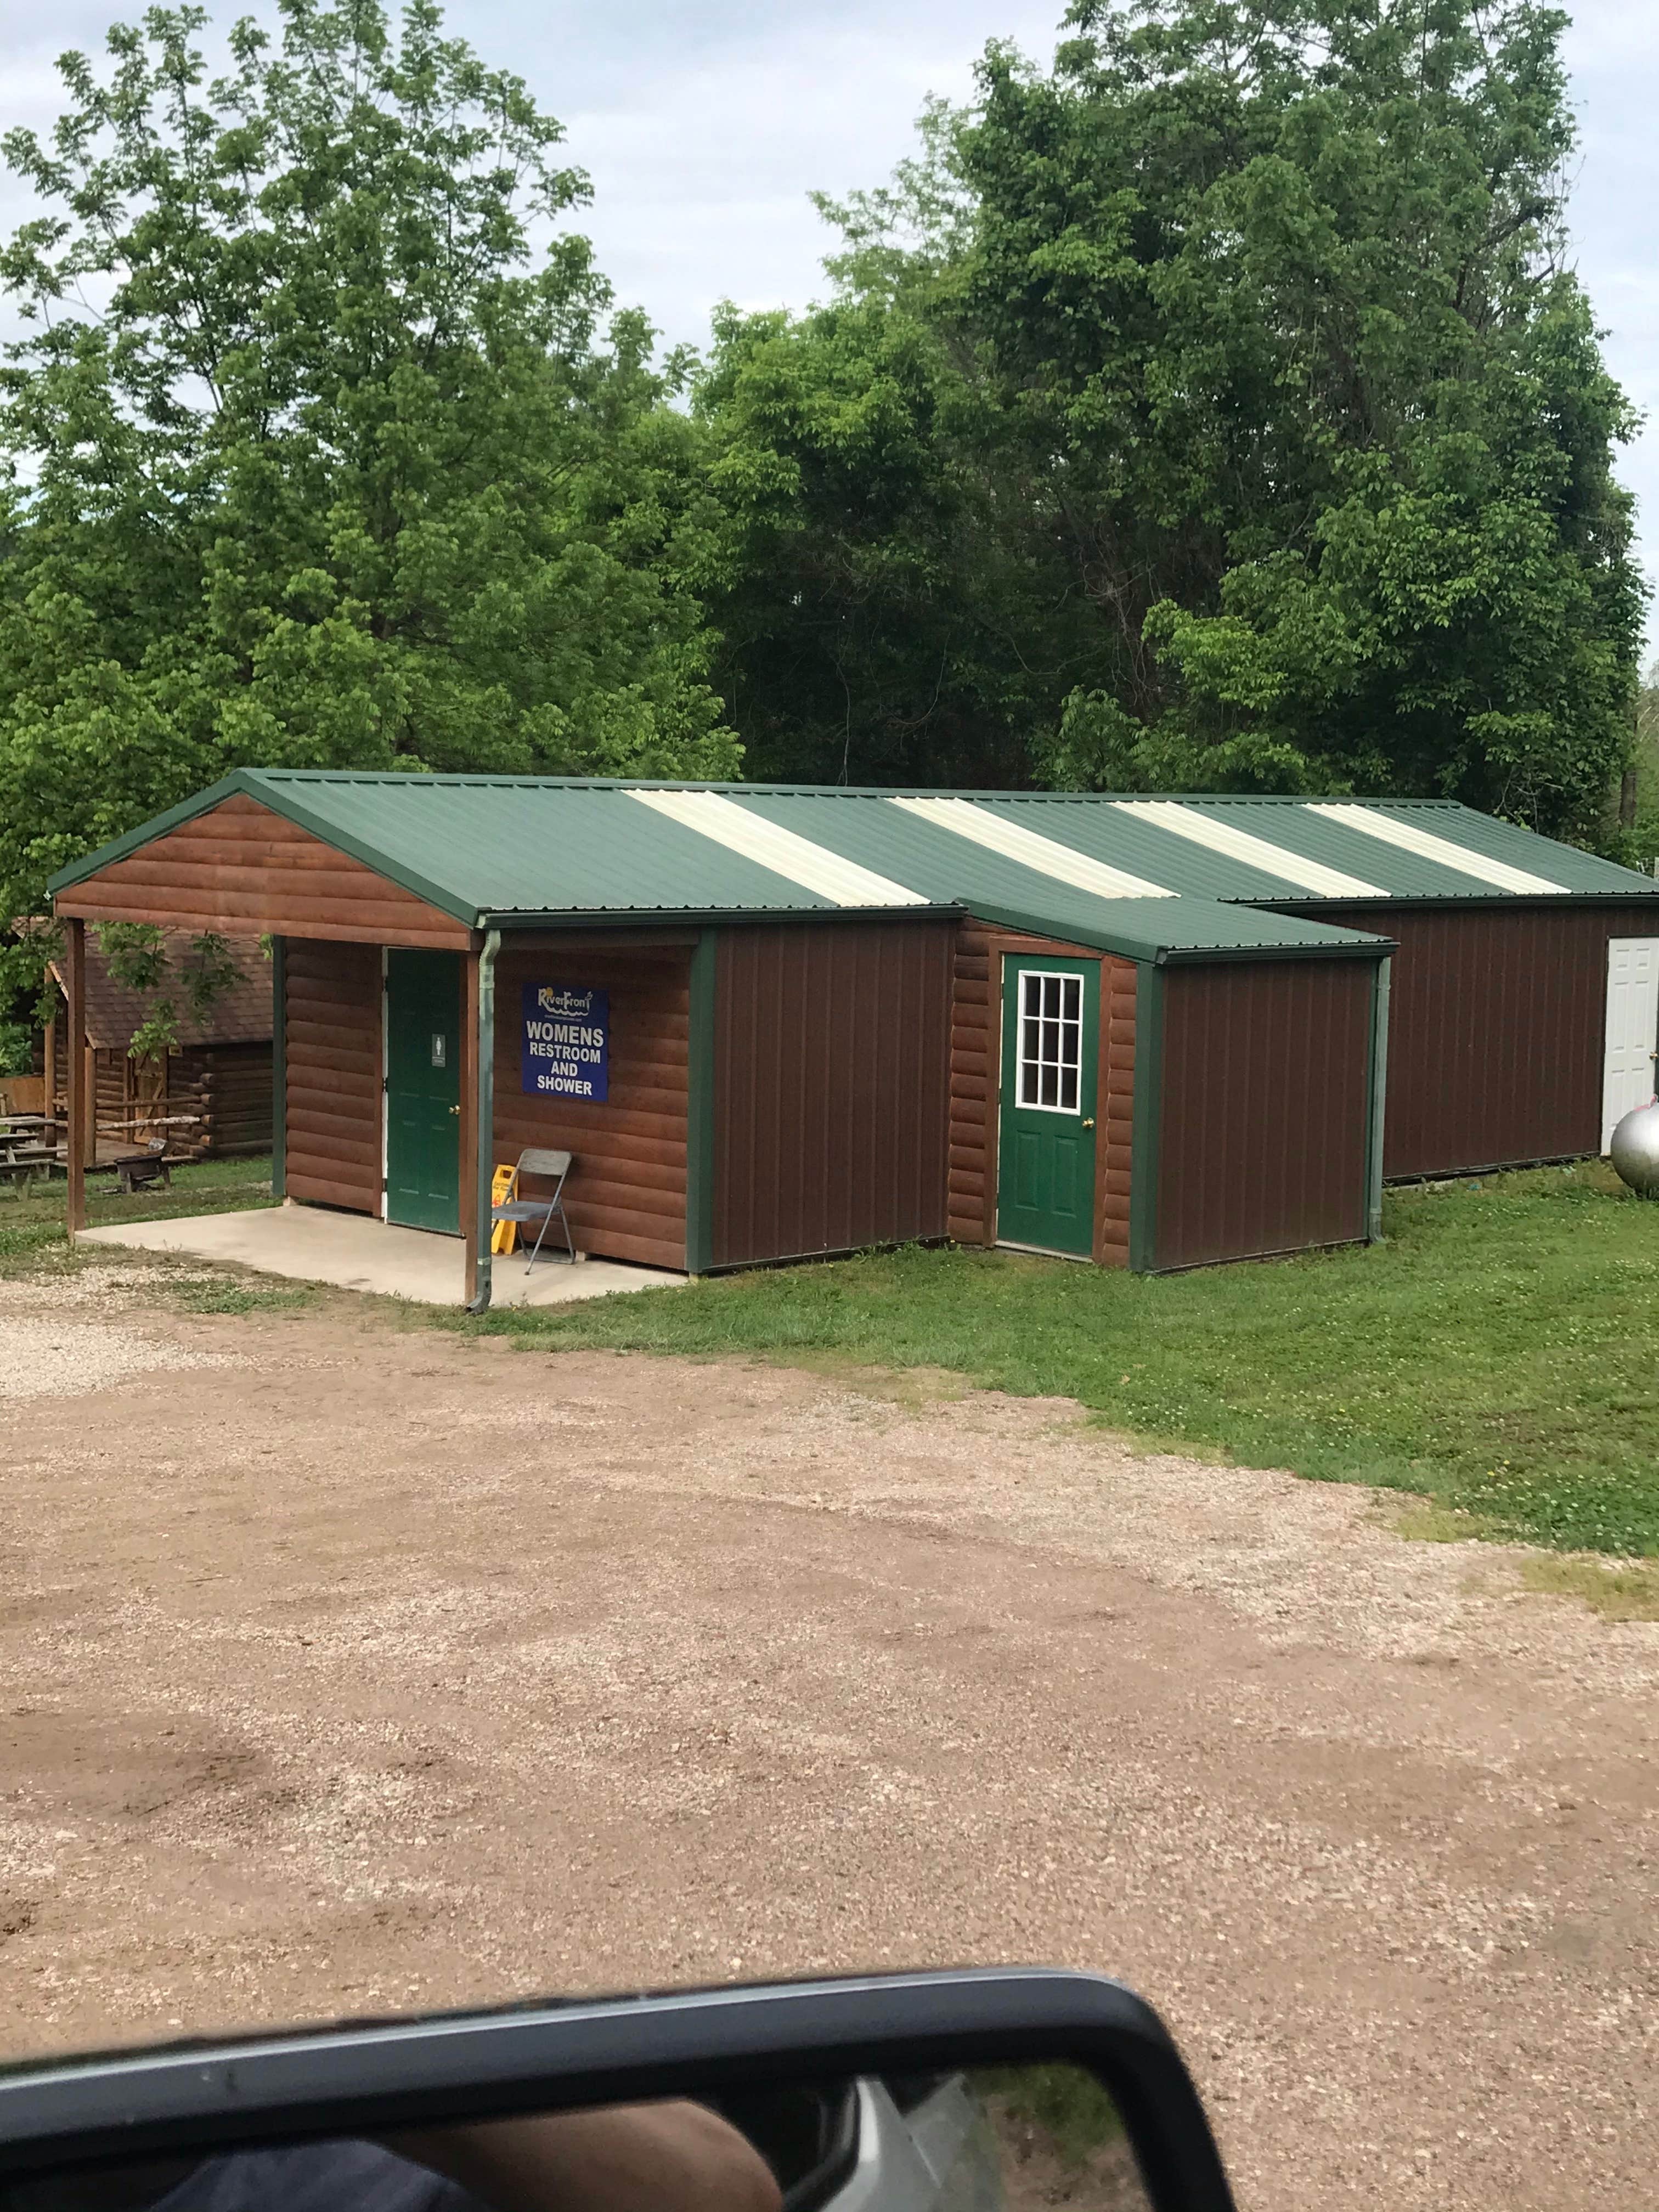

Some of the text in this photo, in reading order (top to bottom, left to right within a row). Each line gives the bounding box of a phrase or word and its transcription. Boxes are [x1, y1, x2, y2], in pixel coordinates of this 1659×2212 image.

[527, 1021, 603, 1047] WOMENS
[530, 1042, 600, 1063] RESTROOM
[551, 1061, 578, 1076] AND
[537, 1075, 592, 1096] SHOWER
